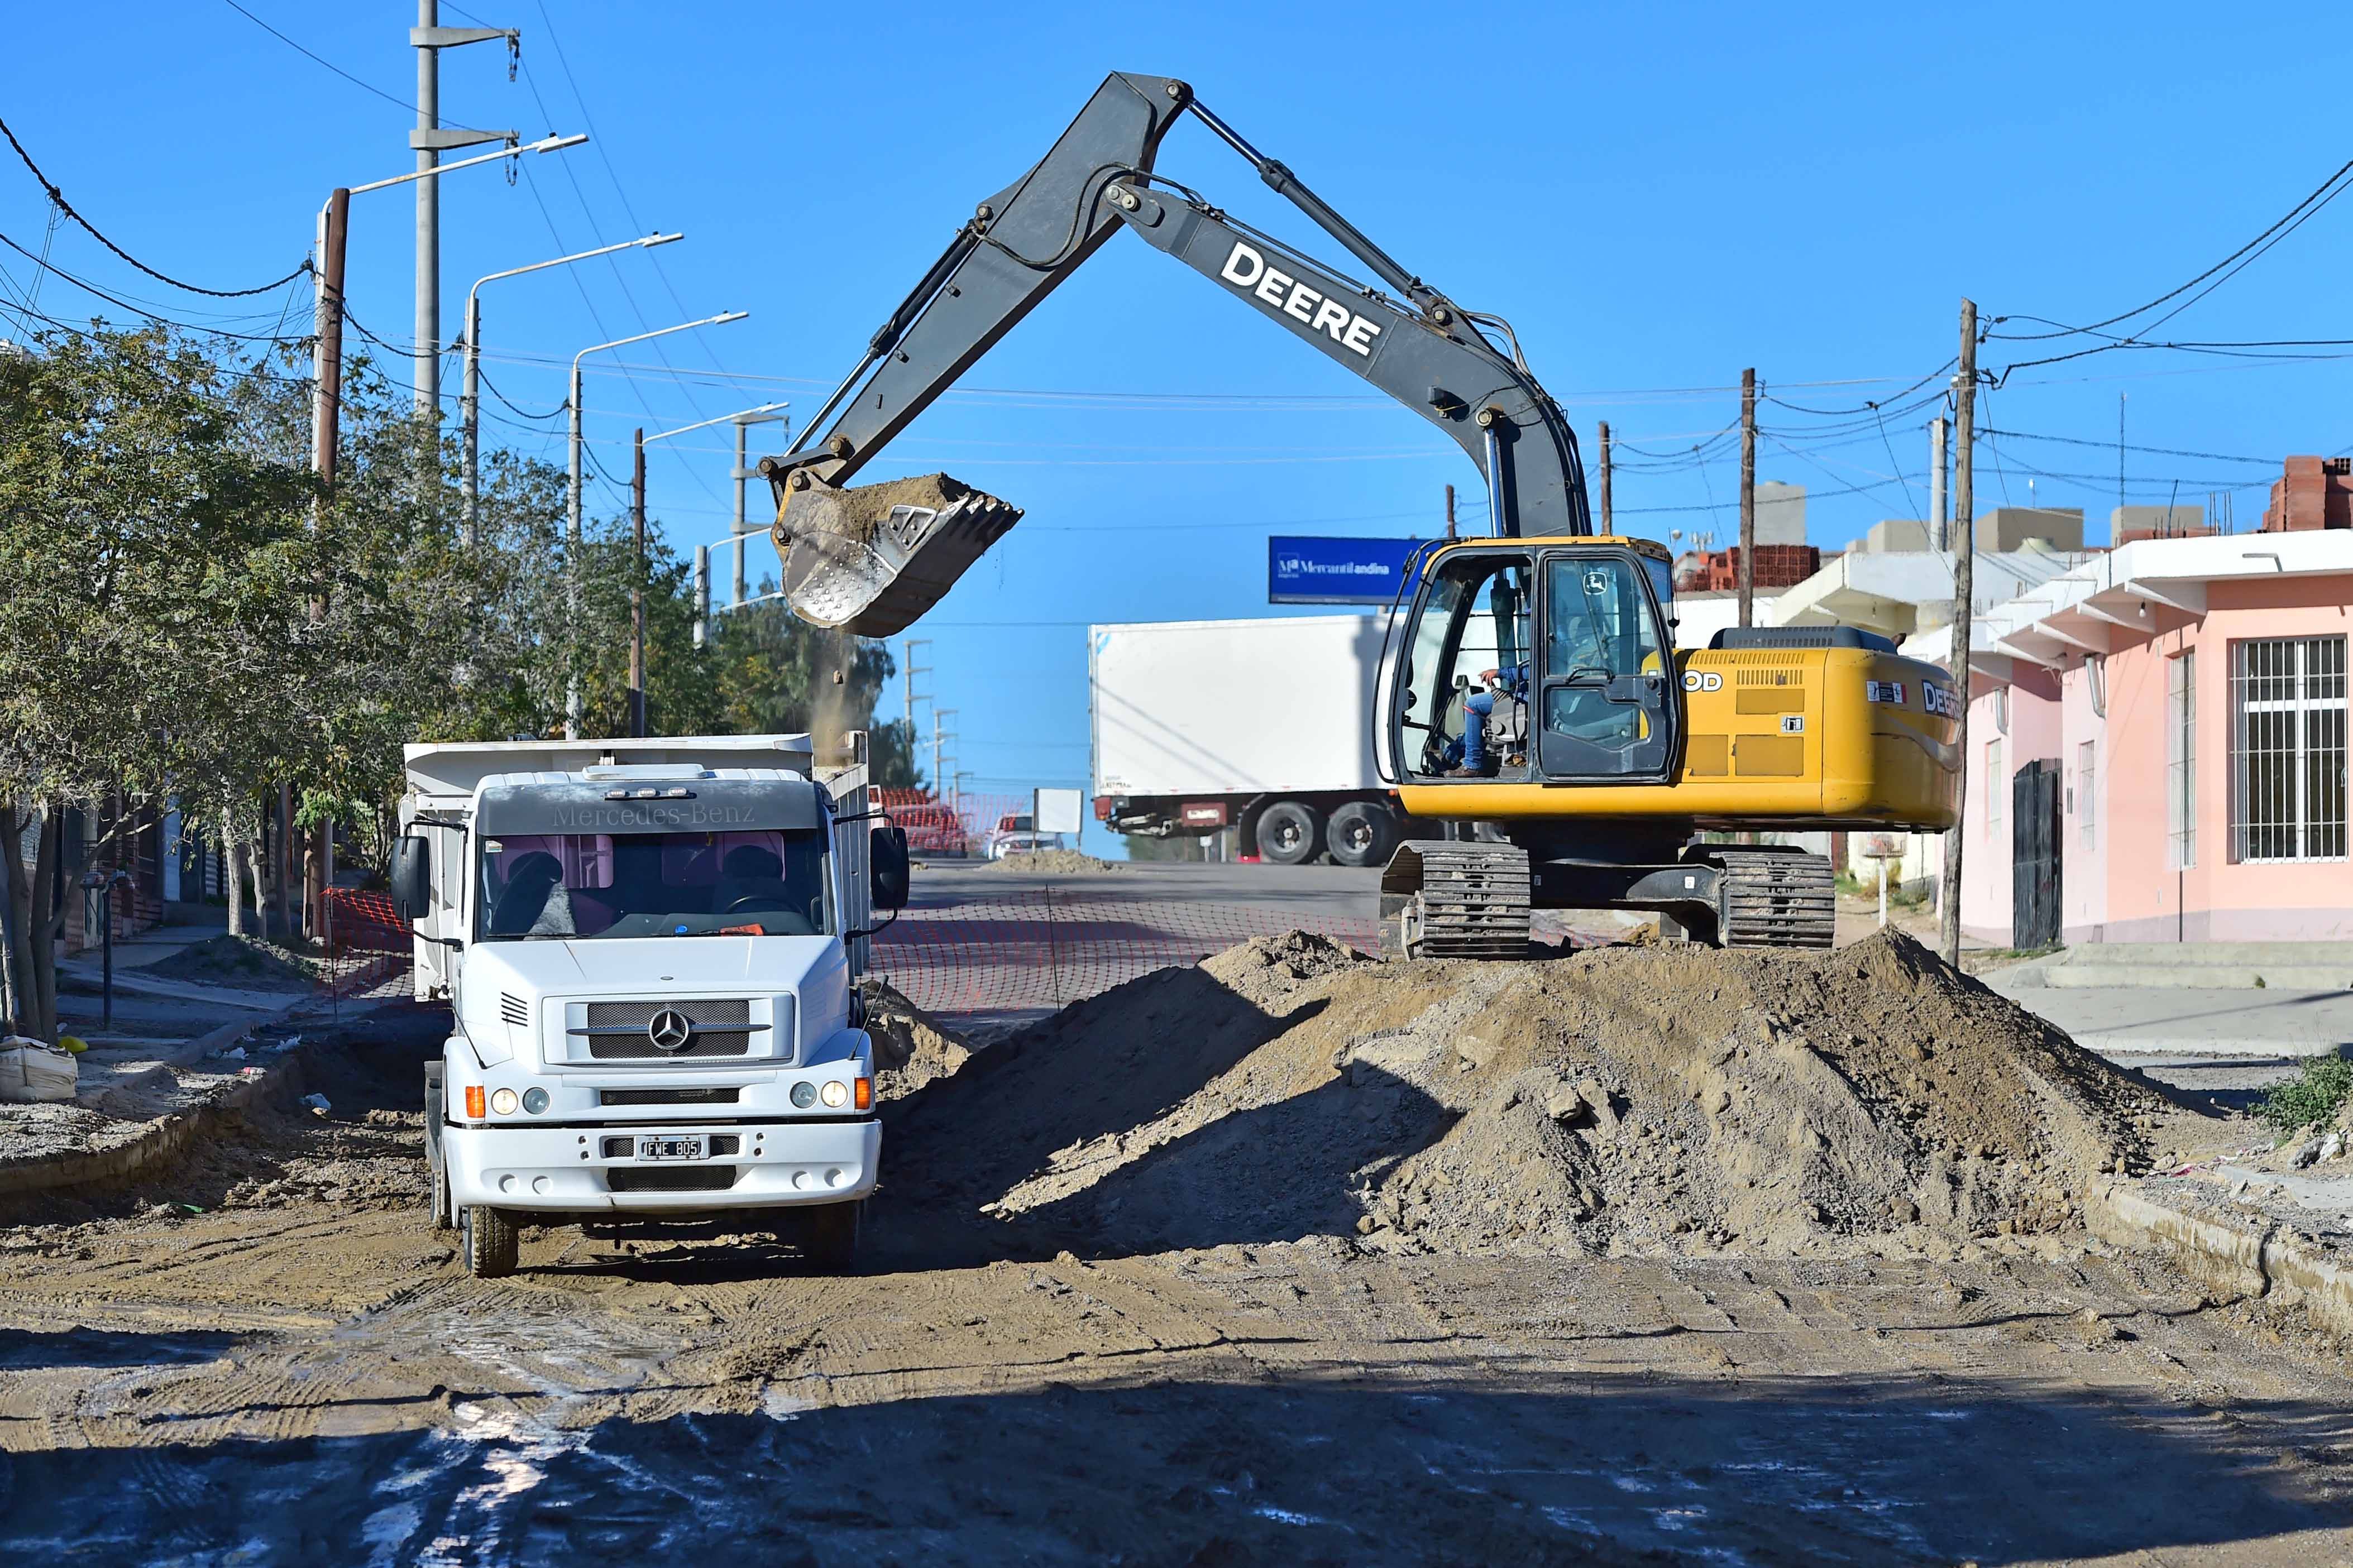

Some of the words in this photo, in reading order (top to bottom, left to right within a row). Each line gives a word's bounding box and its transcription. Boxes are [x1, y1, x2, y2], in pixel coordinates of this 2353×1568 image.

[1221, 241, 1381, 357] DEERE
[553, 803, 755, 827] Mercedes-Benz
[648, 1142, 669, 1155] FWE
[676, 1142, 697, 1155] 805
